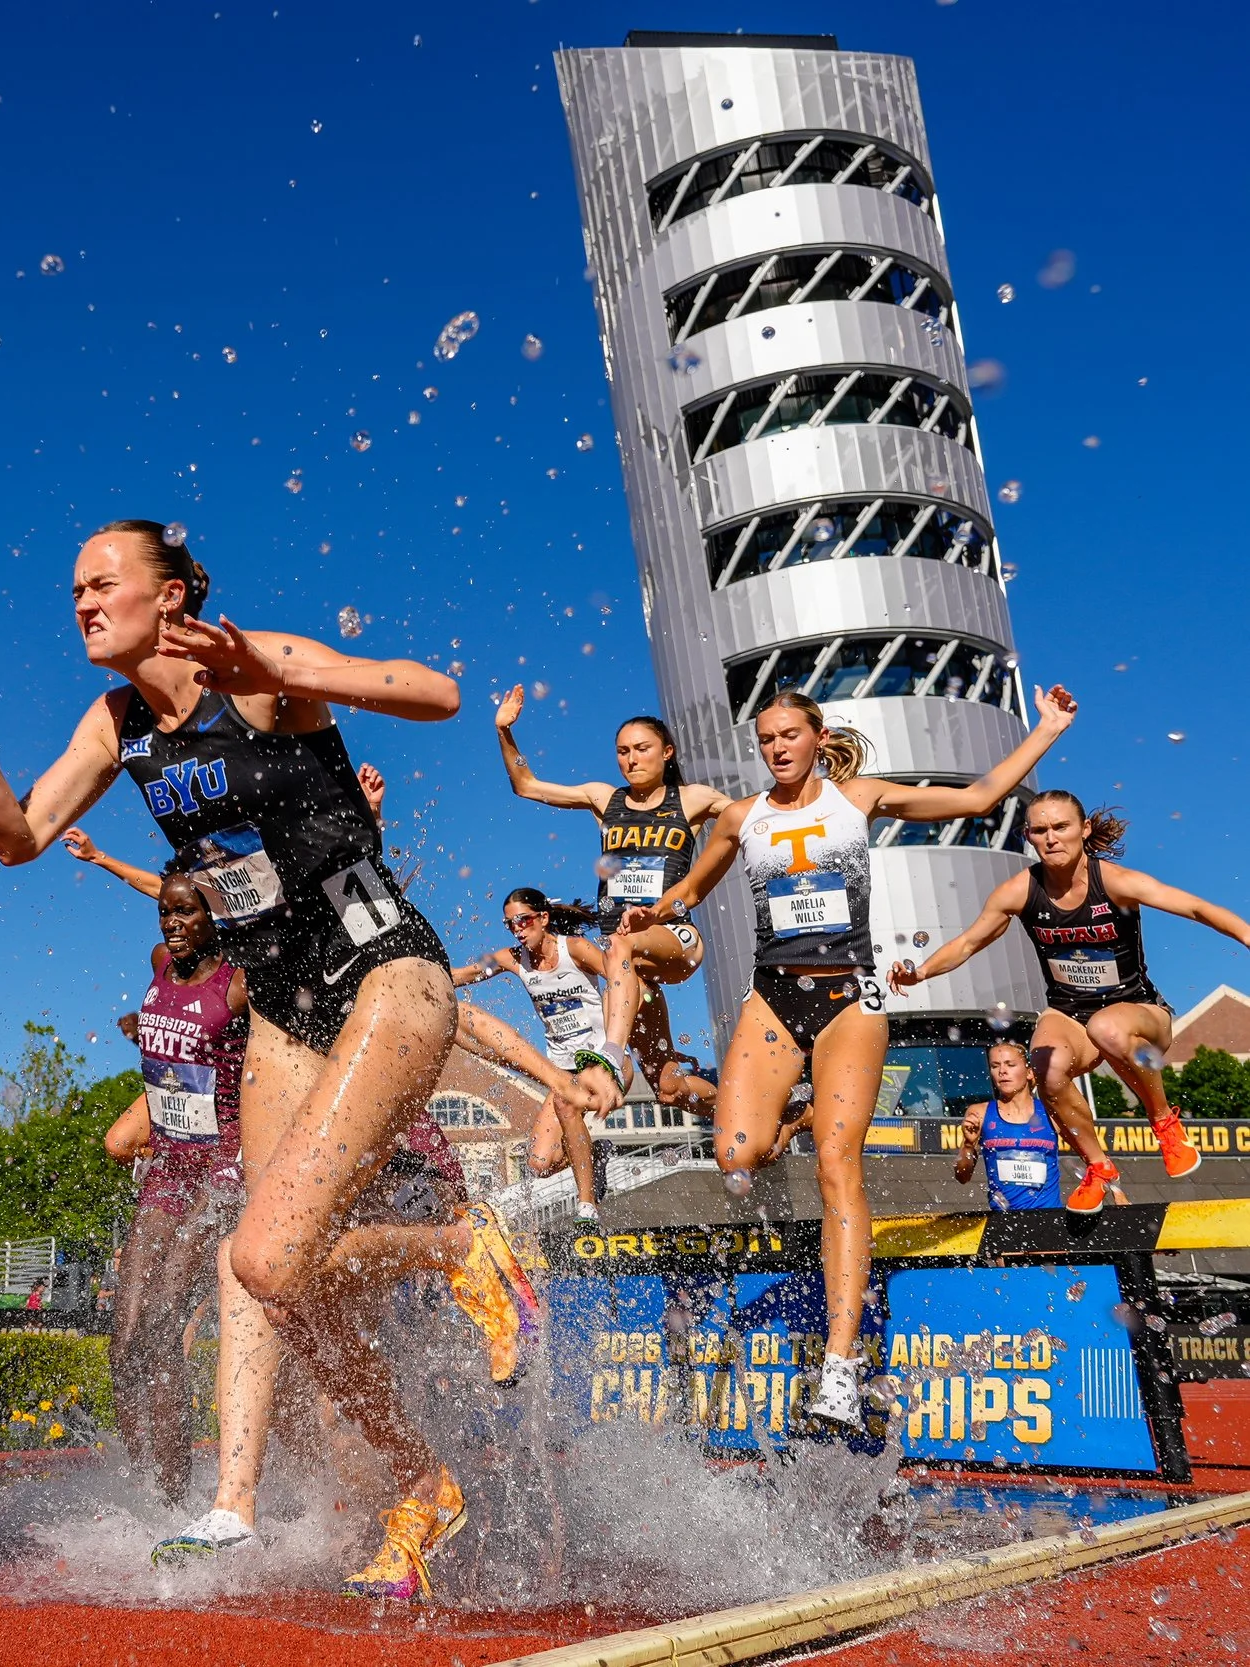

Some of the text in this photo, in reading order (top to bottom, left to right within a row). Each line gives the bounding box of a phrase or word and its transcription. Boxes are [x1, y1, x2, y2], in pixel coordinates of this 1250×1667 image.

[144, 757, 229, 817] BYU
[770, 824, 826, 875] T
[342, 871, 387, 930] 1
[790, 897, 826, 911] AMELIA
[795, 911, 825, 923] WILLS
[1034, 922, 1118, 944] UTAH
[1058, 963, 1107, 975] MACKENZIE
[1067, 974, 1101, 984] ROGERS
[864, 980, 882, 1011] 3
[161, 1095, 187, 1113] NELLY
[1183, 1126, 1230, 1152] ELD
[1013, 1163, 1031, 1172] EMILY
[573, 1229, 782, 1259] OREGON
[890, 1333, 953, 1368] AND
[1178, 1336, 1240, 1360] TRACK
